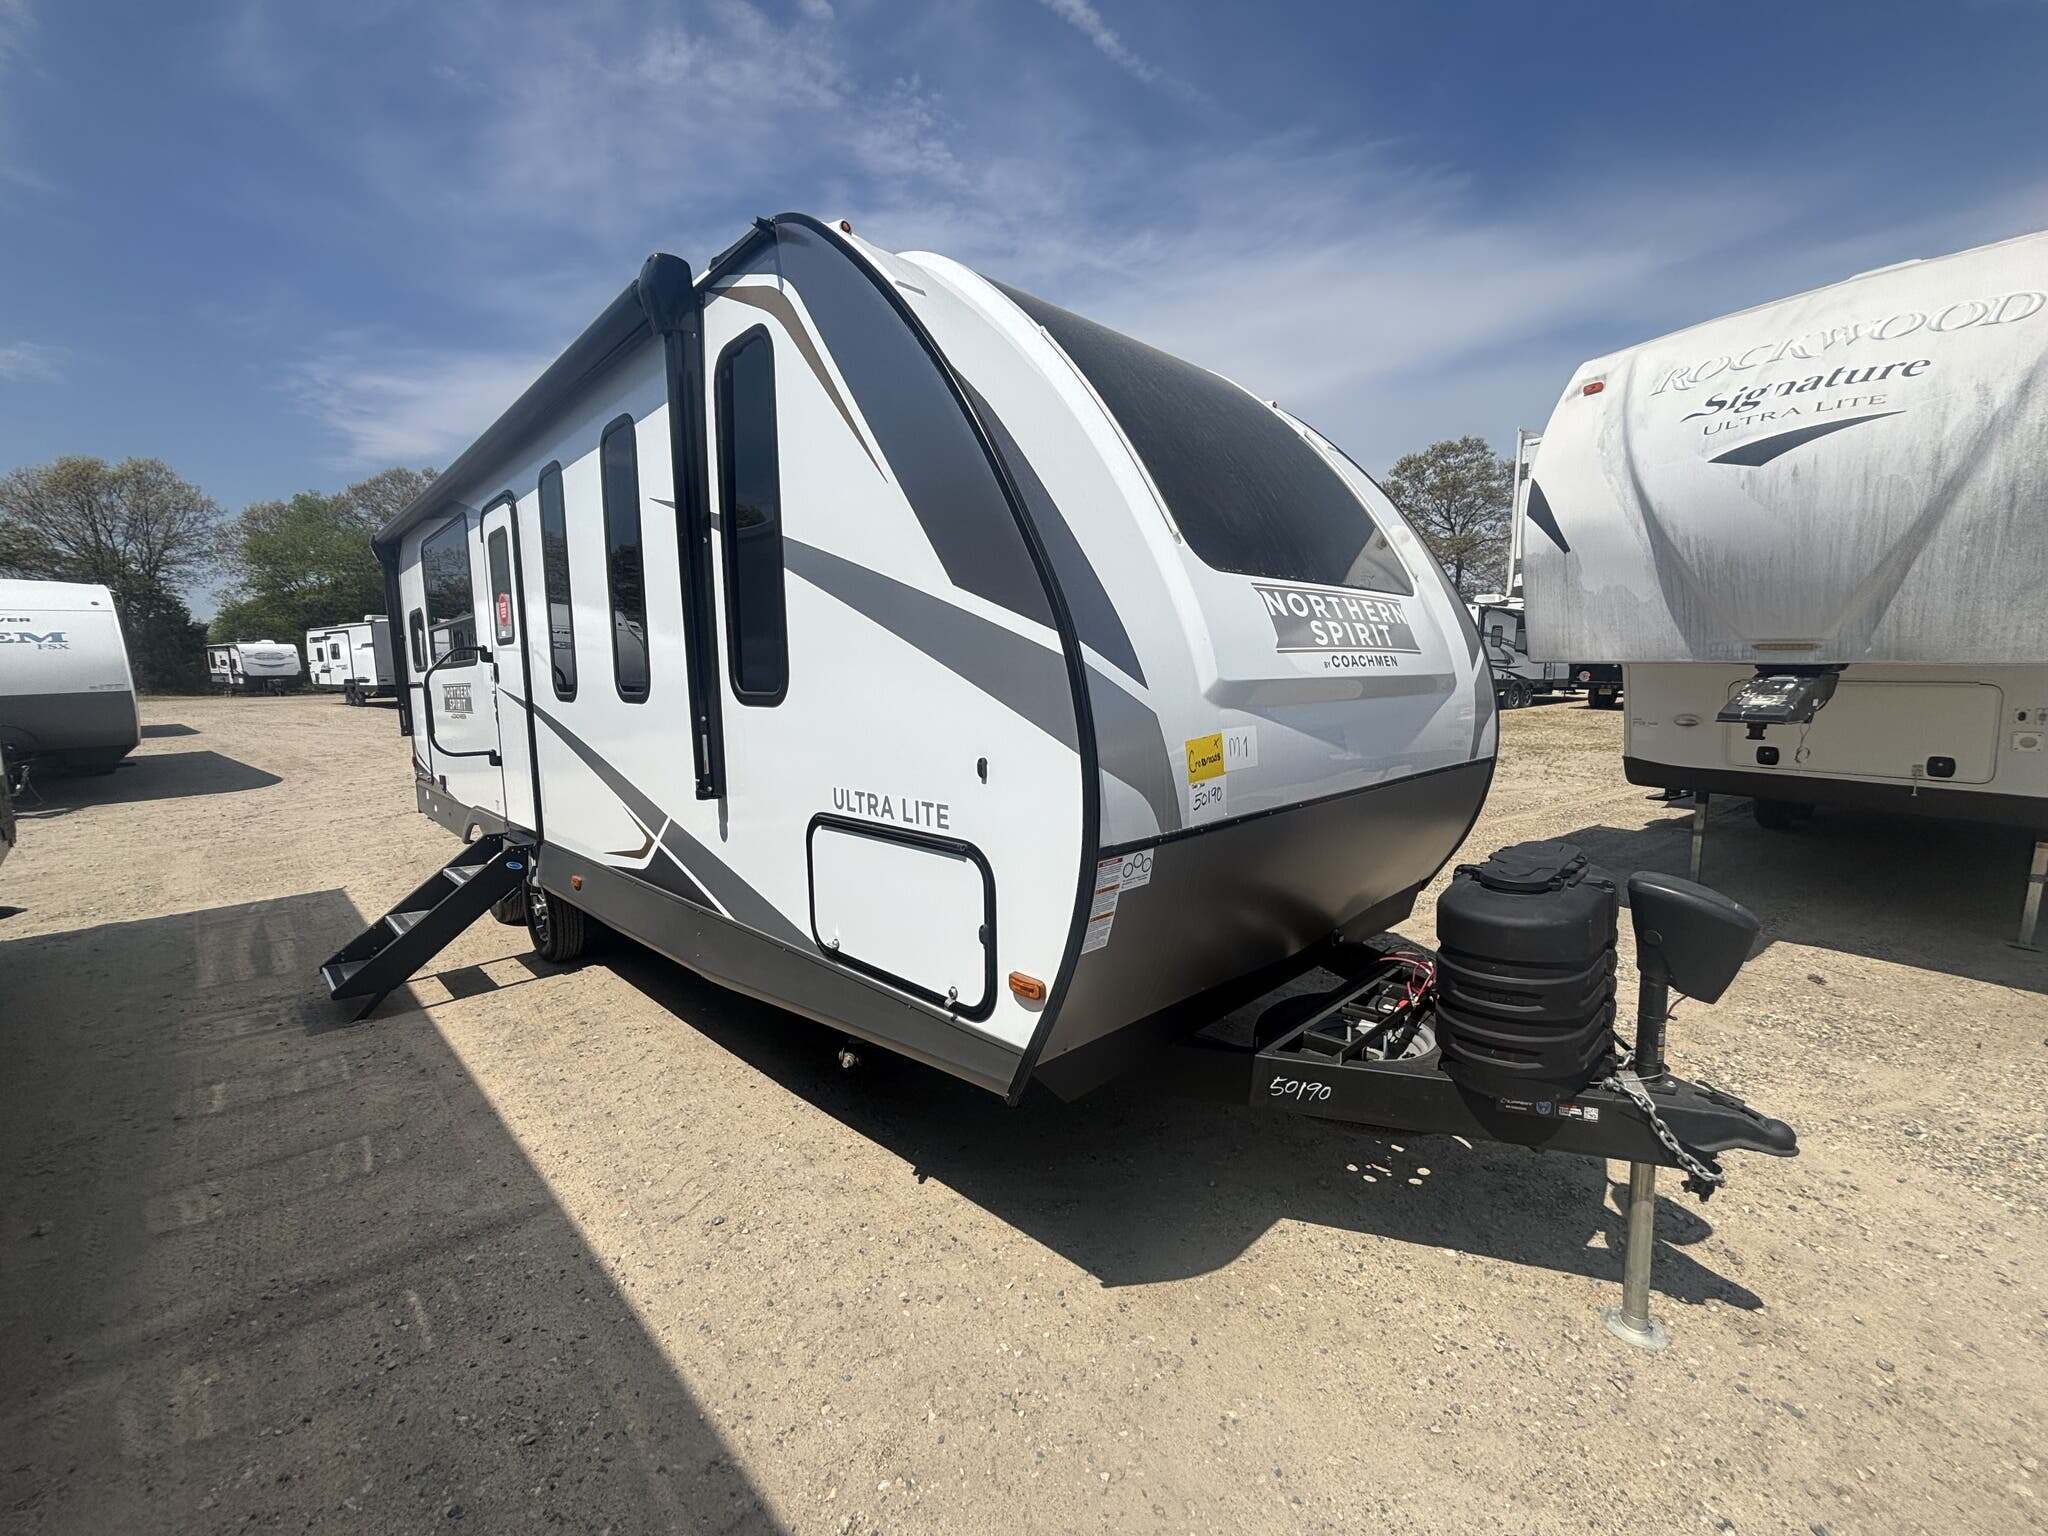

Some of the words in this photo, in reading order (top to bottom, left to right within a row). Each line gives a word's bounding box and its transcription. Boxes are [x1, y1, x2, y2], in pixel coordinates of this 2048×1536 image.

[1650, 291, 2047, 397] ROCKWOOD
[1681, 358, 1932, 423] Signature
[1704, 406, 1801, 436] ULTRA
[1815, 394, 1889, 412] LITE
[1260, 590, 1409, 625] NORTHERN
[1310, 620, 1393, 647] SPIRIT
[1332, 655, 1399, 668] COACHMEN
[833, 787, 895, 820] ULTRA
[902, 798, 950, 830] LITE
[1193, 786, 1223, 811] 50190
[1269, 1076, 1332, 1101] 50190
